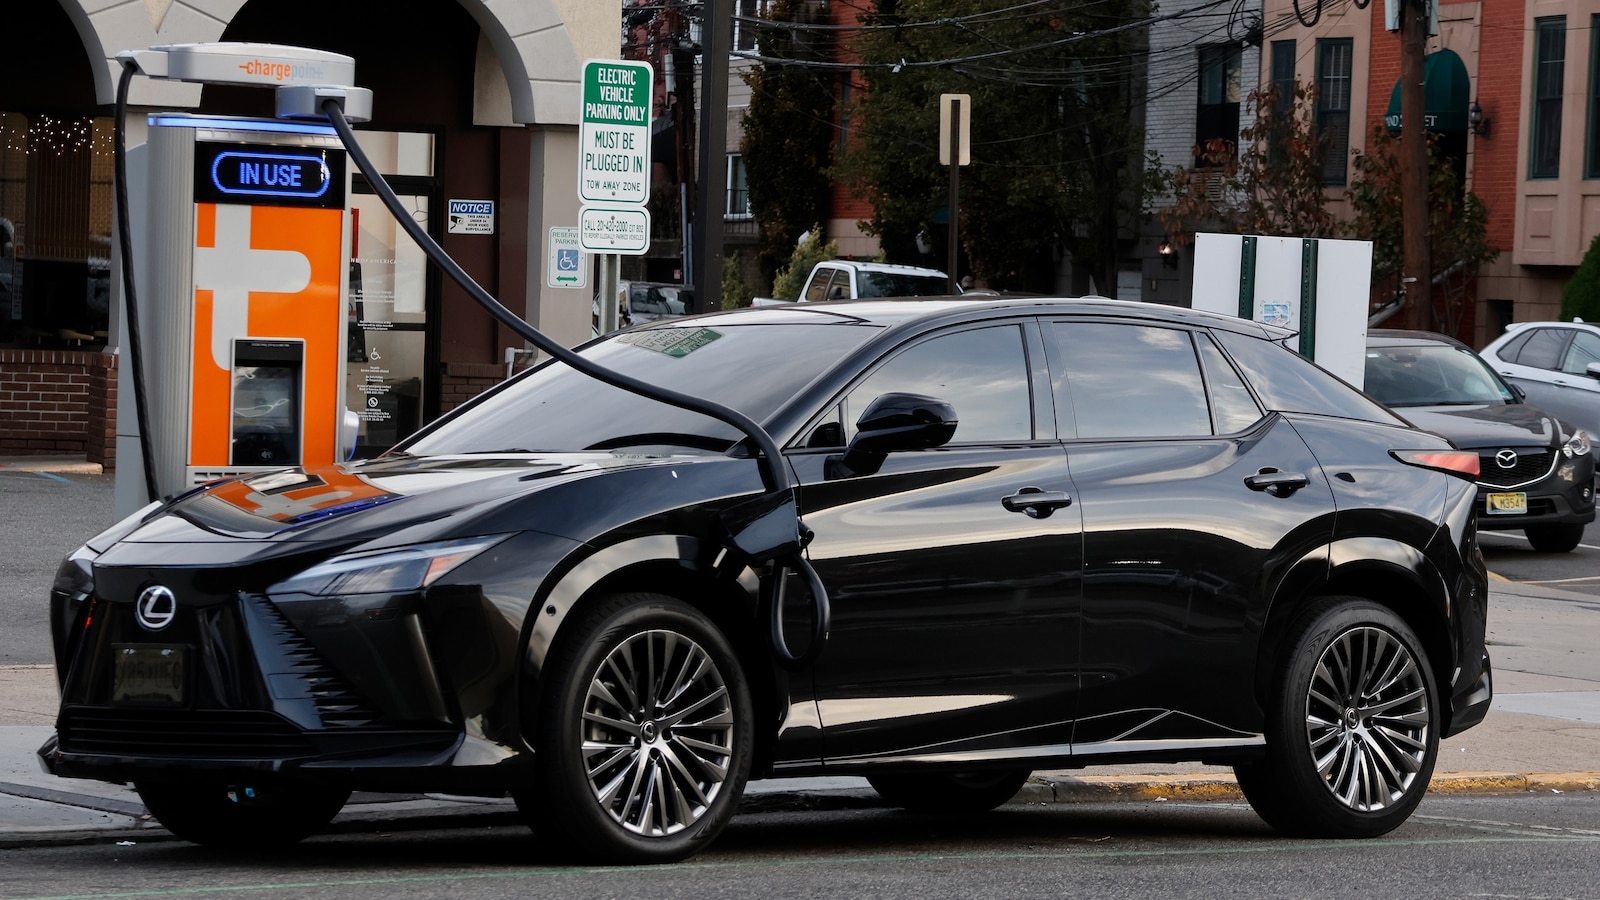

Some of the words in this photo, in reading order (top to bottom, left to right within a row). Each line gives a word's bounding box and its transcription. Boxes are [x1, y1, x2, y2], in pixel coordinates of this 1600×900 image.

[598, 68, 636, 86] ELECTRIC
[600, 86, 634, 103] VEHICLE
[586, 103, 623, 121] PARKING
[624, 105, 646, 122] ONLY
[595, 131, 619, 149] MUST
[622, 133, 635, 150] BE
[585, 154, 629, 172] PLUGGED
[633, 156, 642, 174] IN
[240, 162, 259, 184] IN
[263, 164, 302, 187] USE
[587, 179, 600, 190] TOW
[602, 180, 621, 190] AWAY
[623, 181, 641, 192] ZONE
[452, 204, 490, 213] NOTICE
[585, 220, 596, 231] CALL
[597, 220, 628, 232] 201-420-2000
